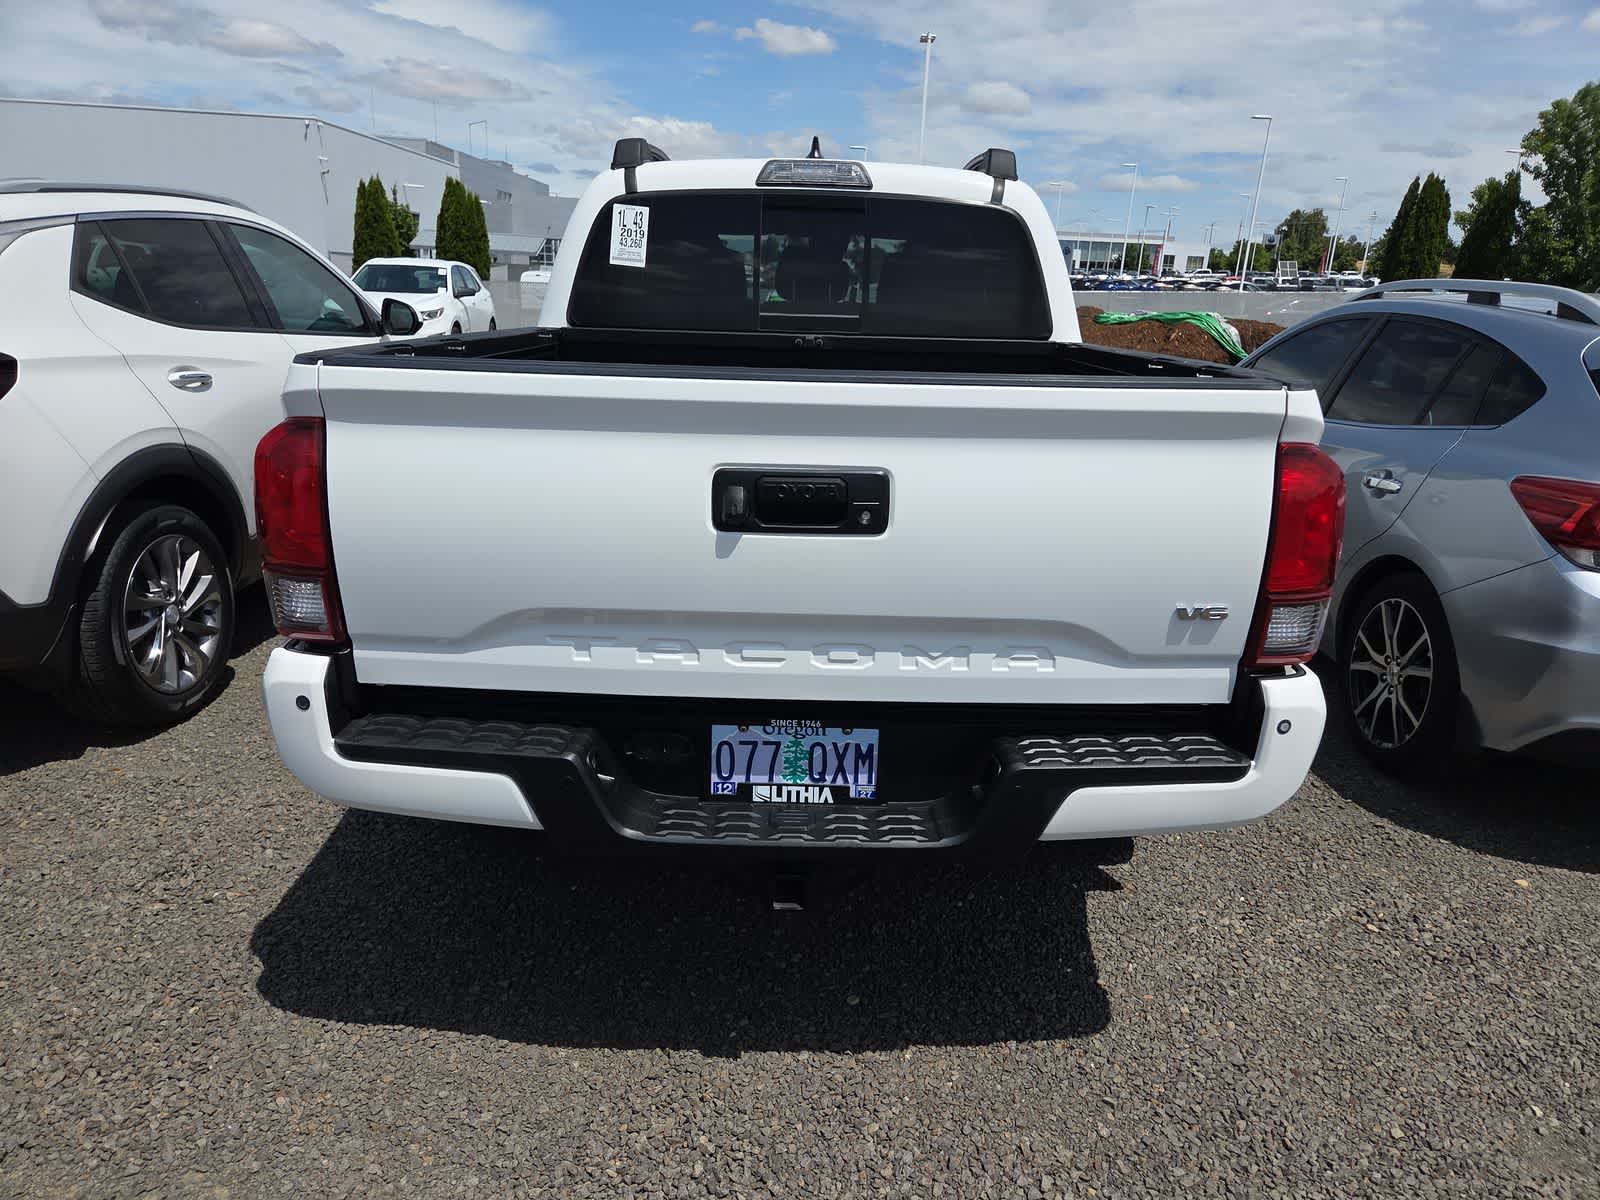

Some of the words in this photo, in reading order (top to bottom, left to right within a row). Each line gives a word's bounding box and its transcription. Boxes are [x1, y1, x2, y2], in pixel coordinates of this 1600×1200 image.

[633, 211, 644, 229] 43
[620, 227, 645, 239] 2019
[546, 635, 1056, 672] TACOMA
[770, 719, 798, 727] SINCE
[801, 720, 821, 728] 1946
[762, 726, 828, 739] Oregon
[808, 741, 874, 785] QXM
[716, 783, 732, 794] 12
[771, 786, 834, 803] LITHIA
[859, 790, 873, 798] 27
